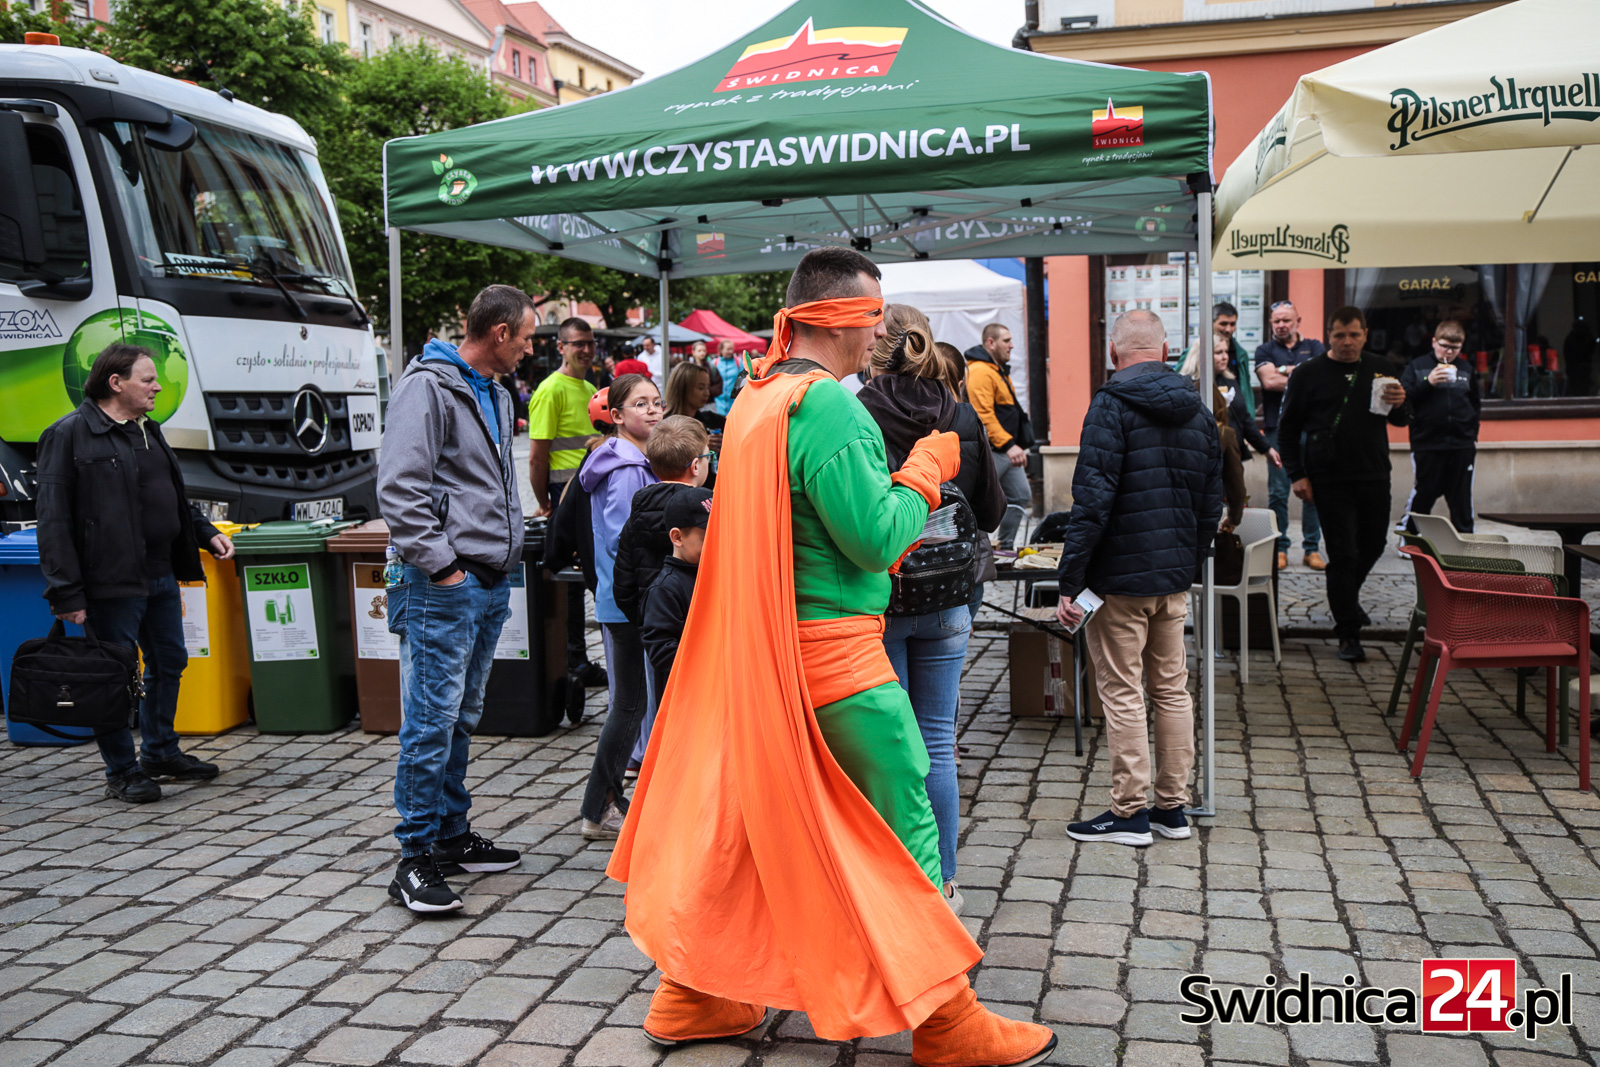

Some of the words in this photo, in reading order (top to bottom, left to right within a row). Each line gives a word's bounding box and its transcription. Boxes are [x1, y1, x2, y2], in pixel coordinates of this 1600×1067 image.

[663, 94, 743, 115] rynek
[746, 94, 764, 103] z
[769, 79, 920, 101] tradycjami
[1387, 87, 1495, 151] Pilsner
[1489, 73, 1600, 127] Urquell
[531, 123, 1031, 185] WWW.CZYSTASWIDNICA.PL
[1082, 153, 1105, 166] rynek
[1112, 150, 1154, 164] tradycjami
[1399, 275, 1451, 290] GARAŻ
[1574, 271, 1600, 283] GA
[0, 308, 62, 337] ZOM
[236, 351, 266, 373] czysto
[273, 343, 307, 368] solidnie
[313, 346, 360, 375] profesjonalnie
[352, 413, 375, 432] ODPADY
[296, 503, 313, 520] WWL
[316, 500, 341, 518] 742AC
[254, 571, 299, 585] SZKŁO
